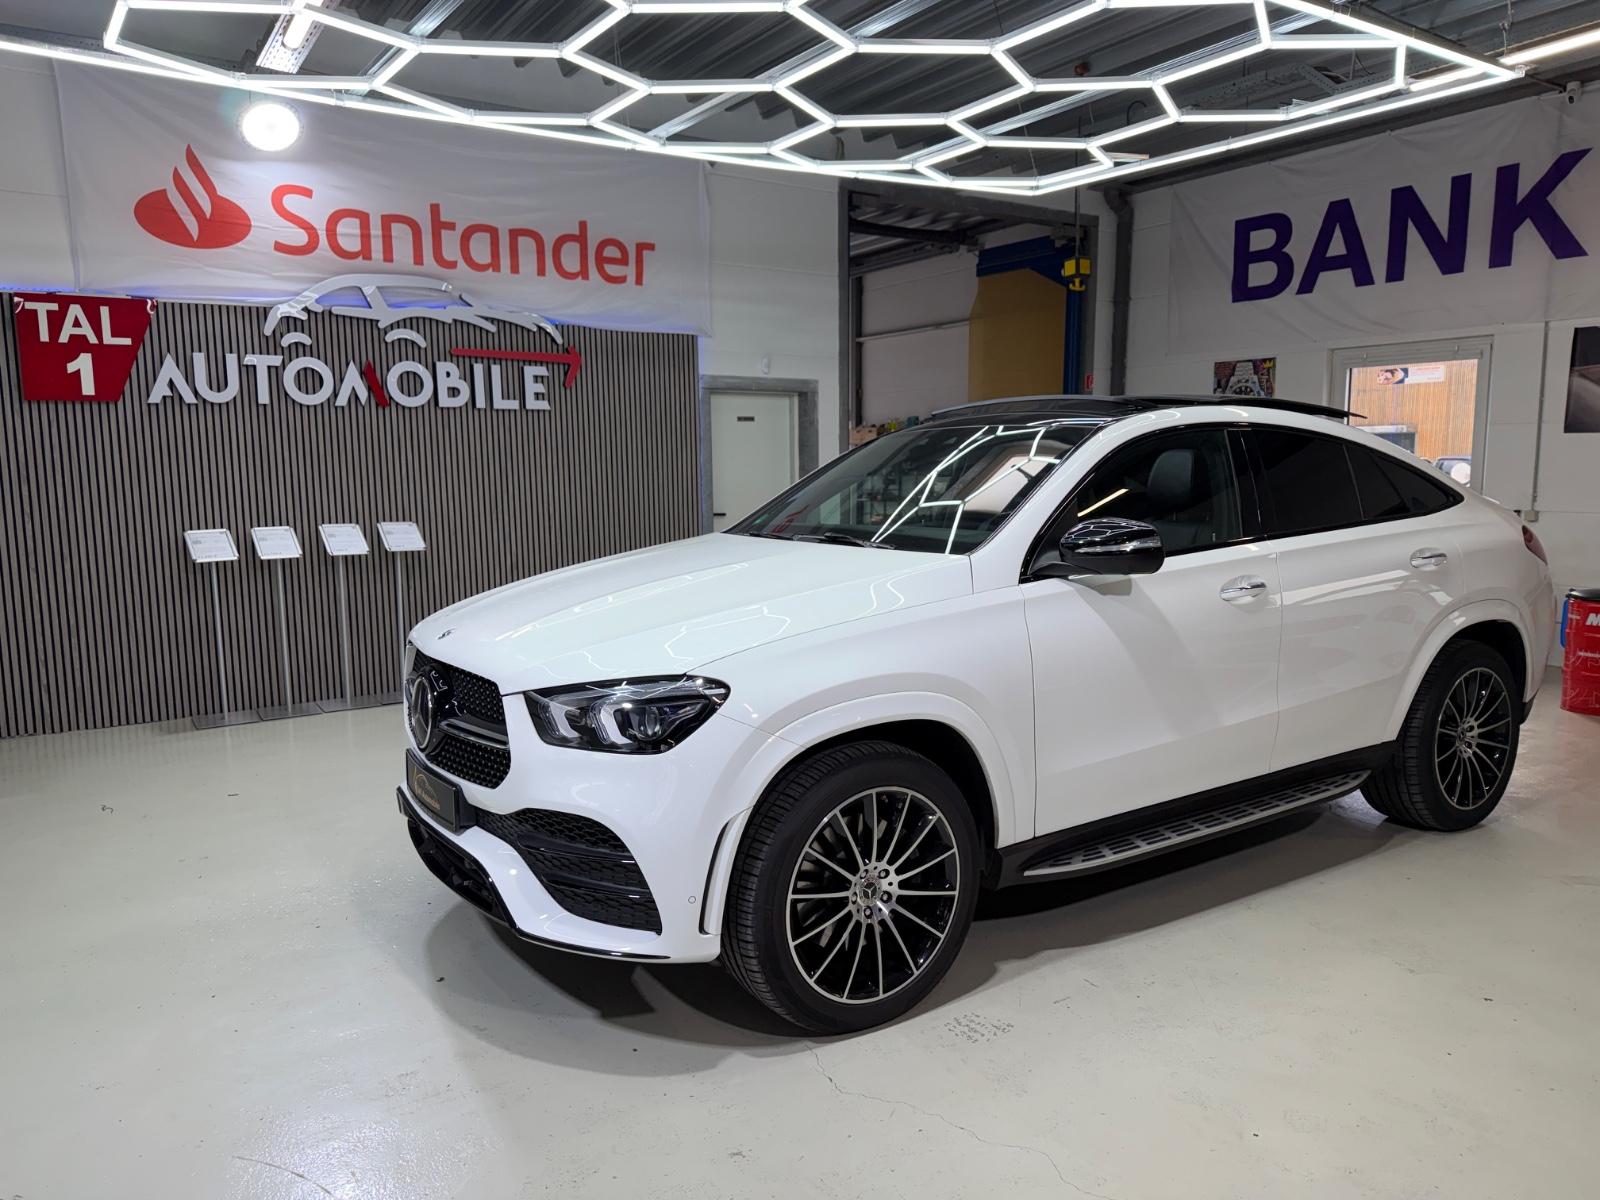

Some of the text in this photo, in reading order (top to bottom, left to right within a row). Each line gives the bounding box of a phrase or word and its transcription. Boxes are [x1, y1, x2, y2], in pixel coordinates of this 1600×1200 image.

[270, 184, 655, 286] Santander
[1231, 148, 1592, 303] BANK
[24, 301, 132, 345] TAL
[66, 352, 96, 395] 1
[147, 352, 551, 410] AUTOMOBILE
